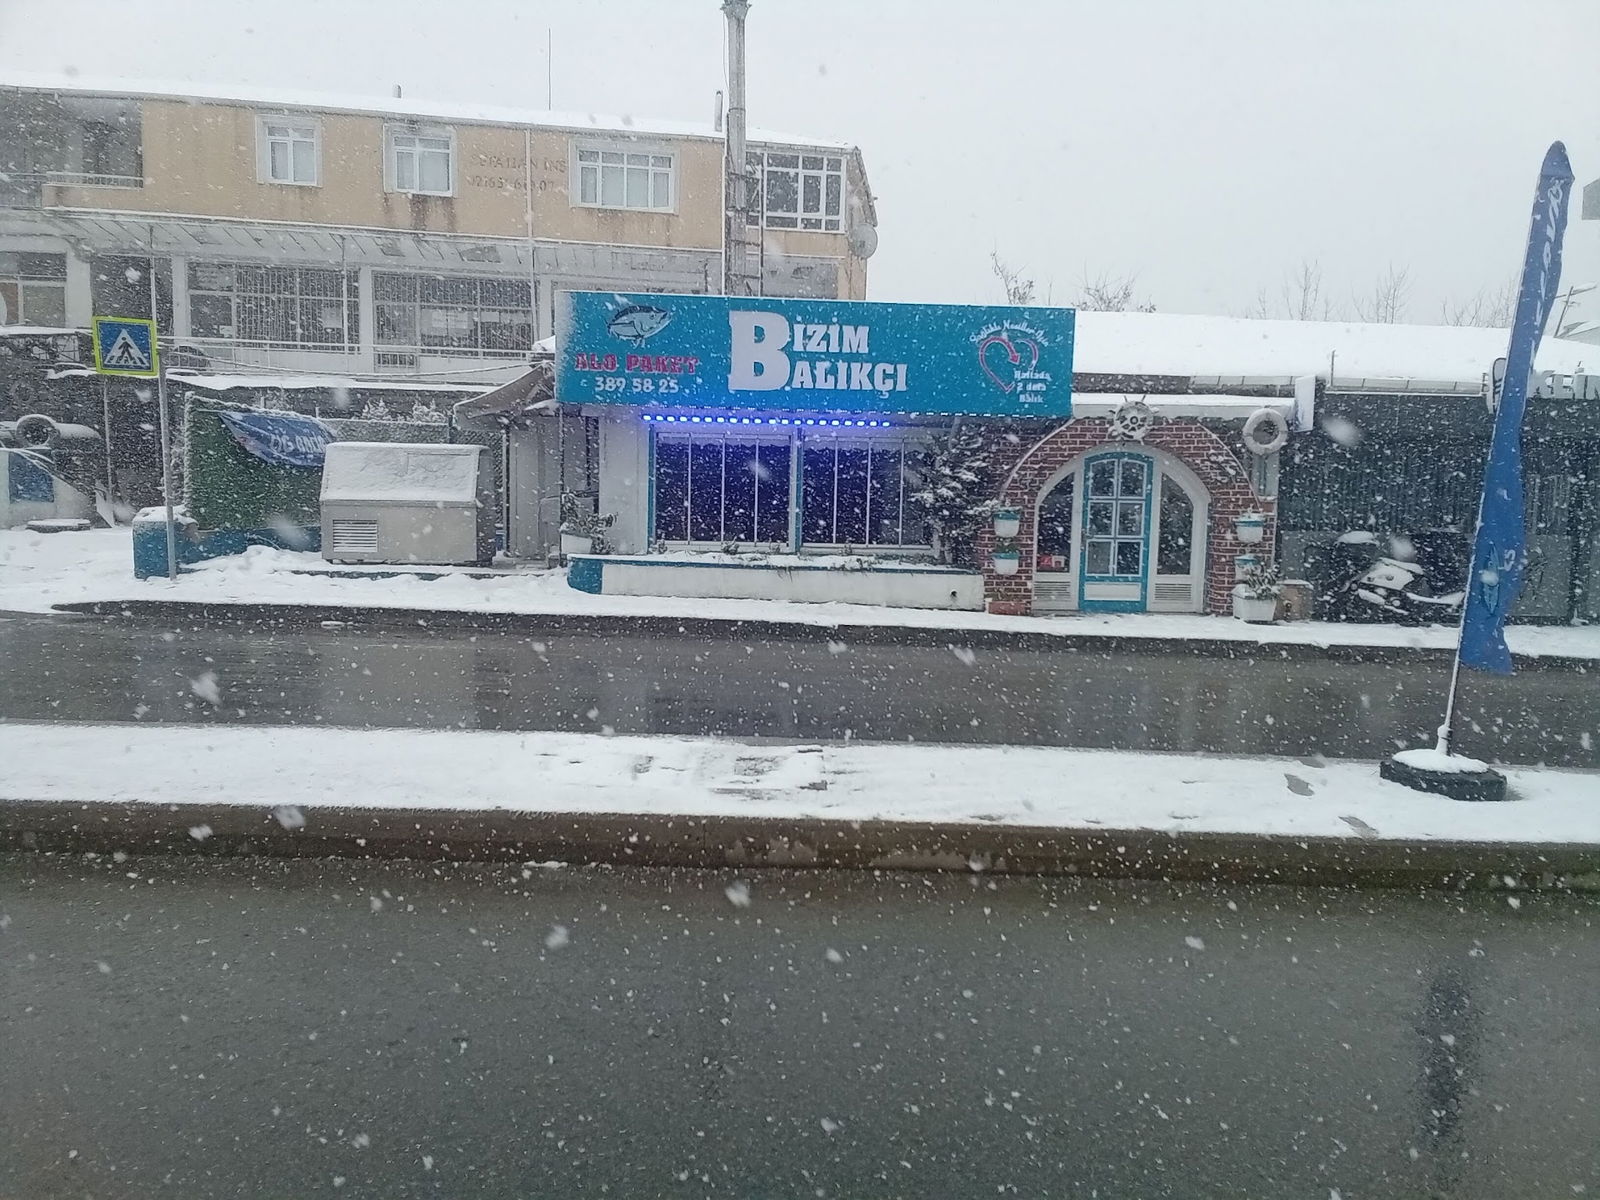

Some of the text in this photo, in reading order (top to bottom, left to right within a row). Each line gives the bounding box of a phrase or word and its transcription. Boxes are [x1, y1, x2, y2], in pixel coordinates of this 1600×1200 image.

[574, 353, 700, 375] ALO PAKET
[594, 376, 679, 394] 389 58 25
